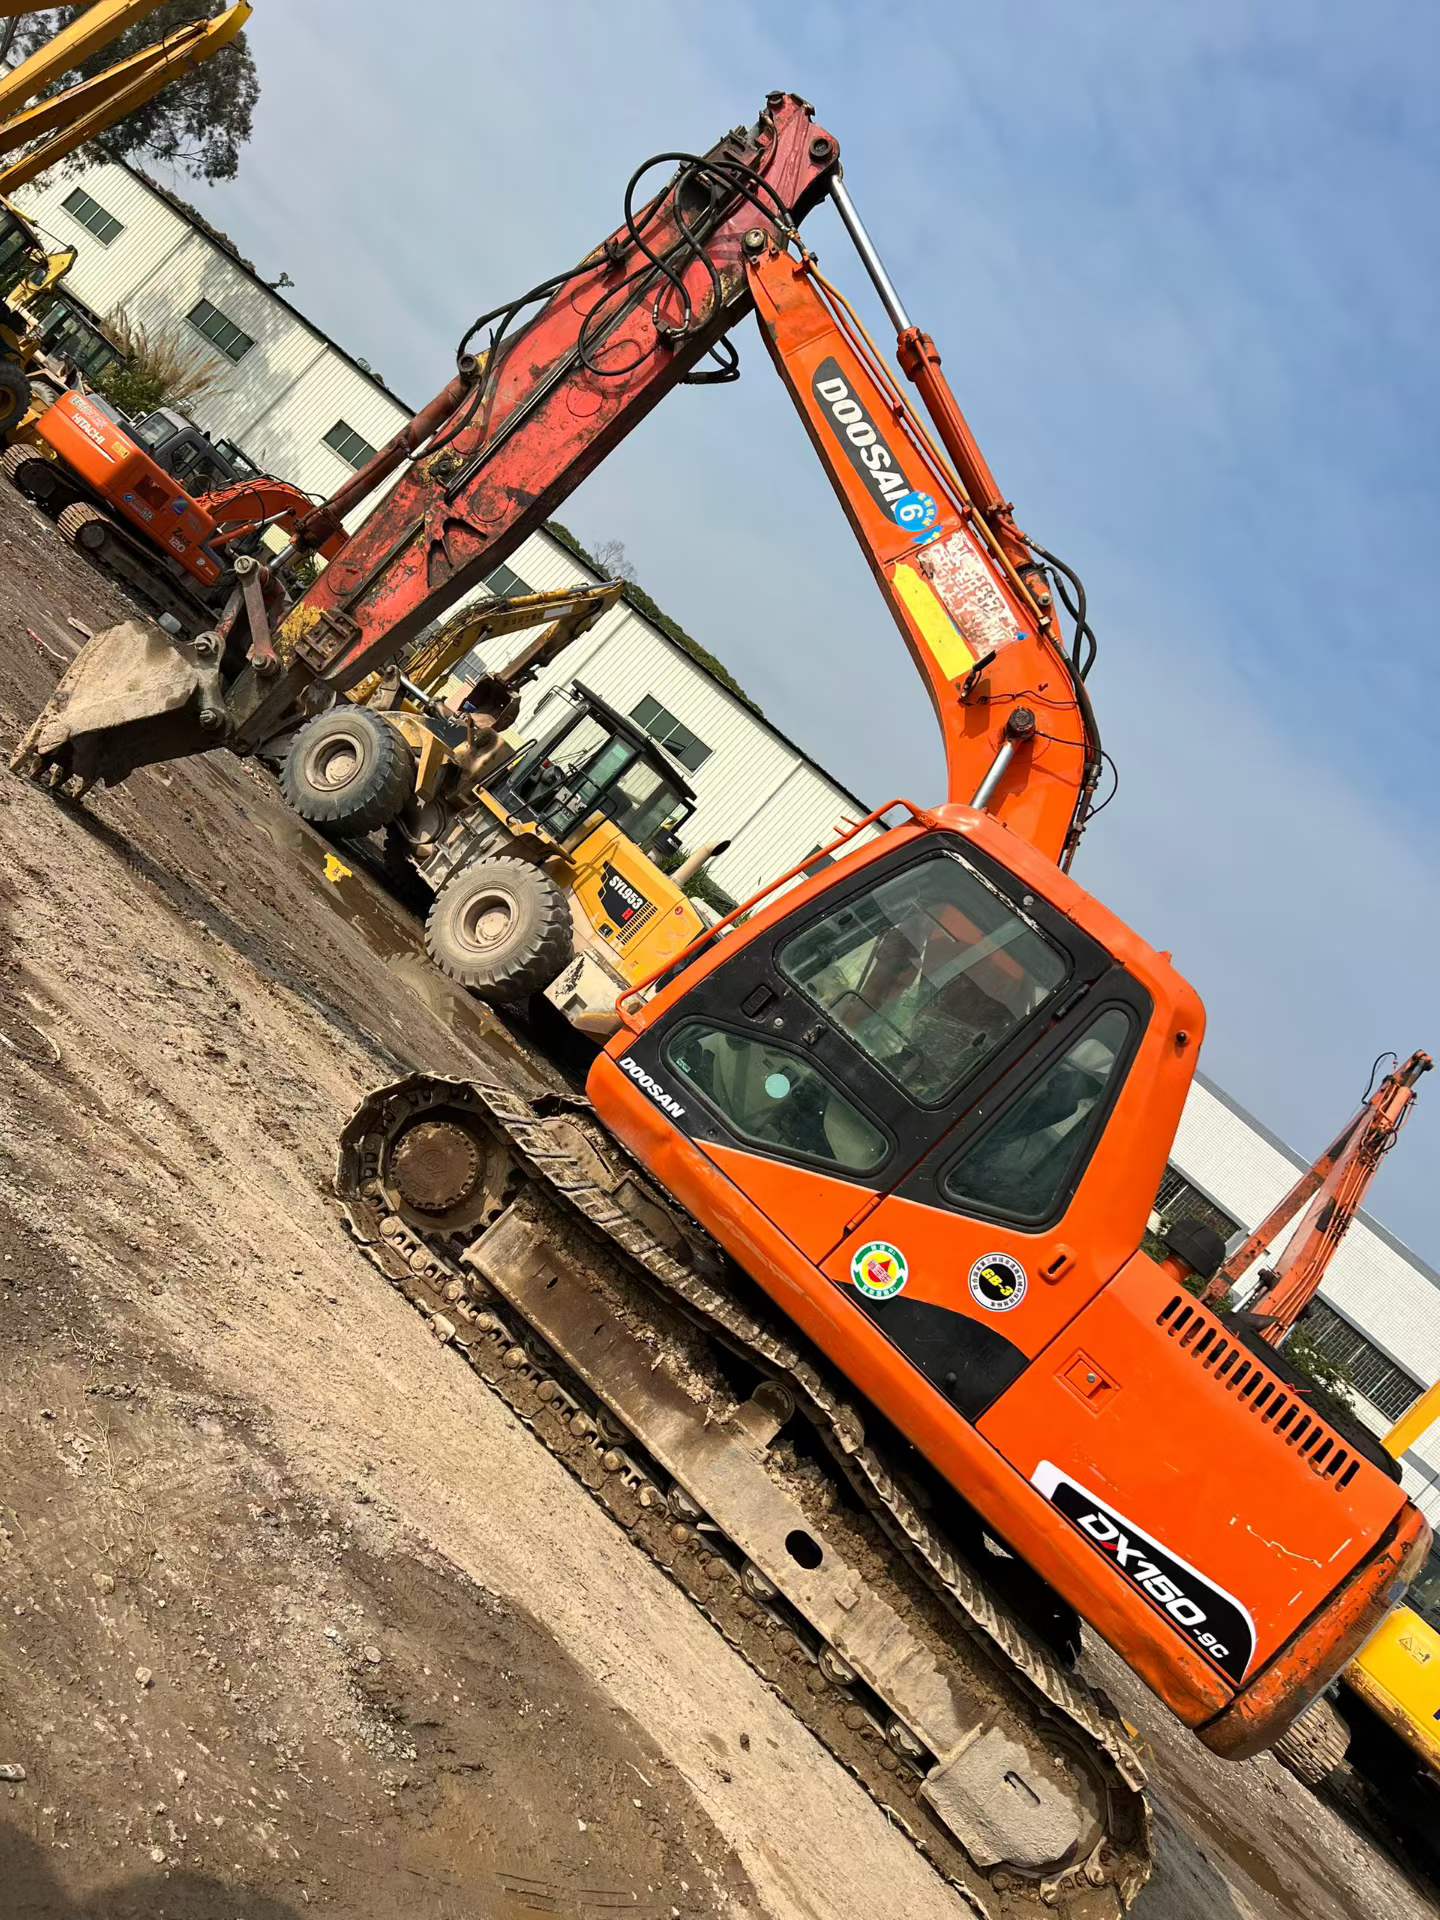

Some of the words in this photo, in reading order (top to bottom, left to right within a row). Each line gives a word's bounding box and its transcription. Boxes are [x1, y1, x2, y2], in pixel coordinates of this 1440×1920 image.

[71, 413, 106, 445] HITACHI
[168, 536, 186, 553] 120
[608, 875, 644, 910] SYL953
[618, 1056, 687, 1119] DOOSAN
[981, 1268, 1014, 1297] GB-3
